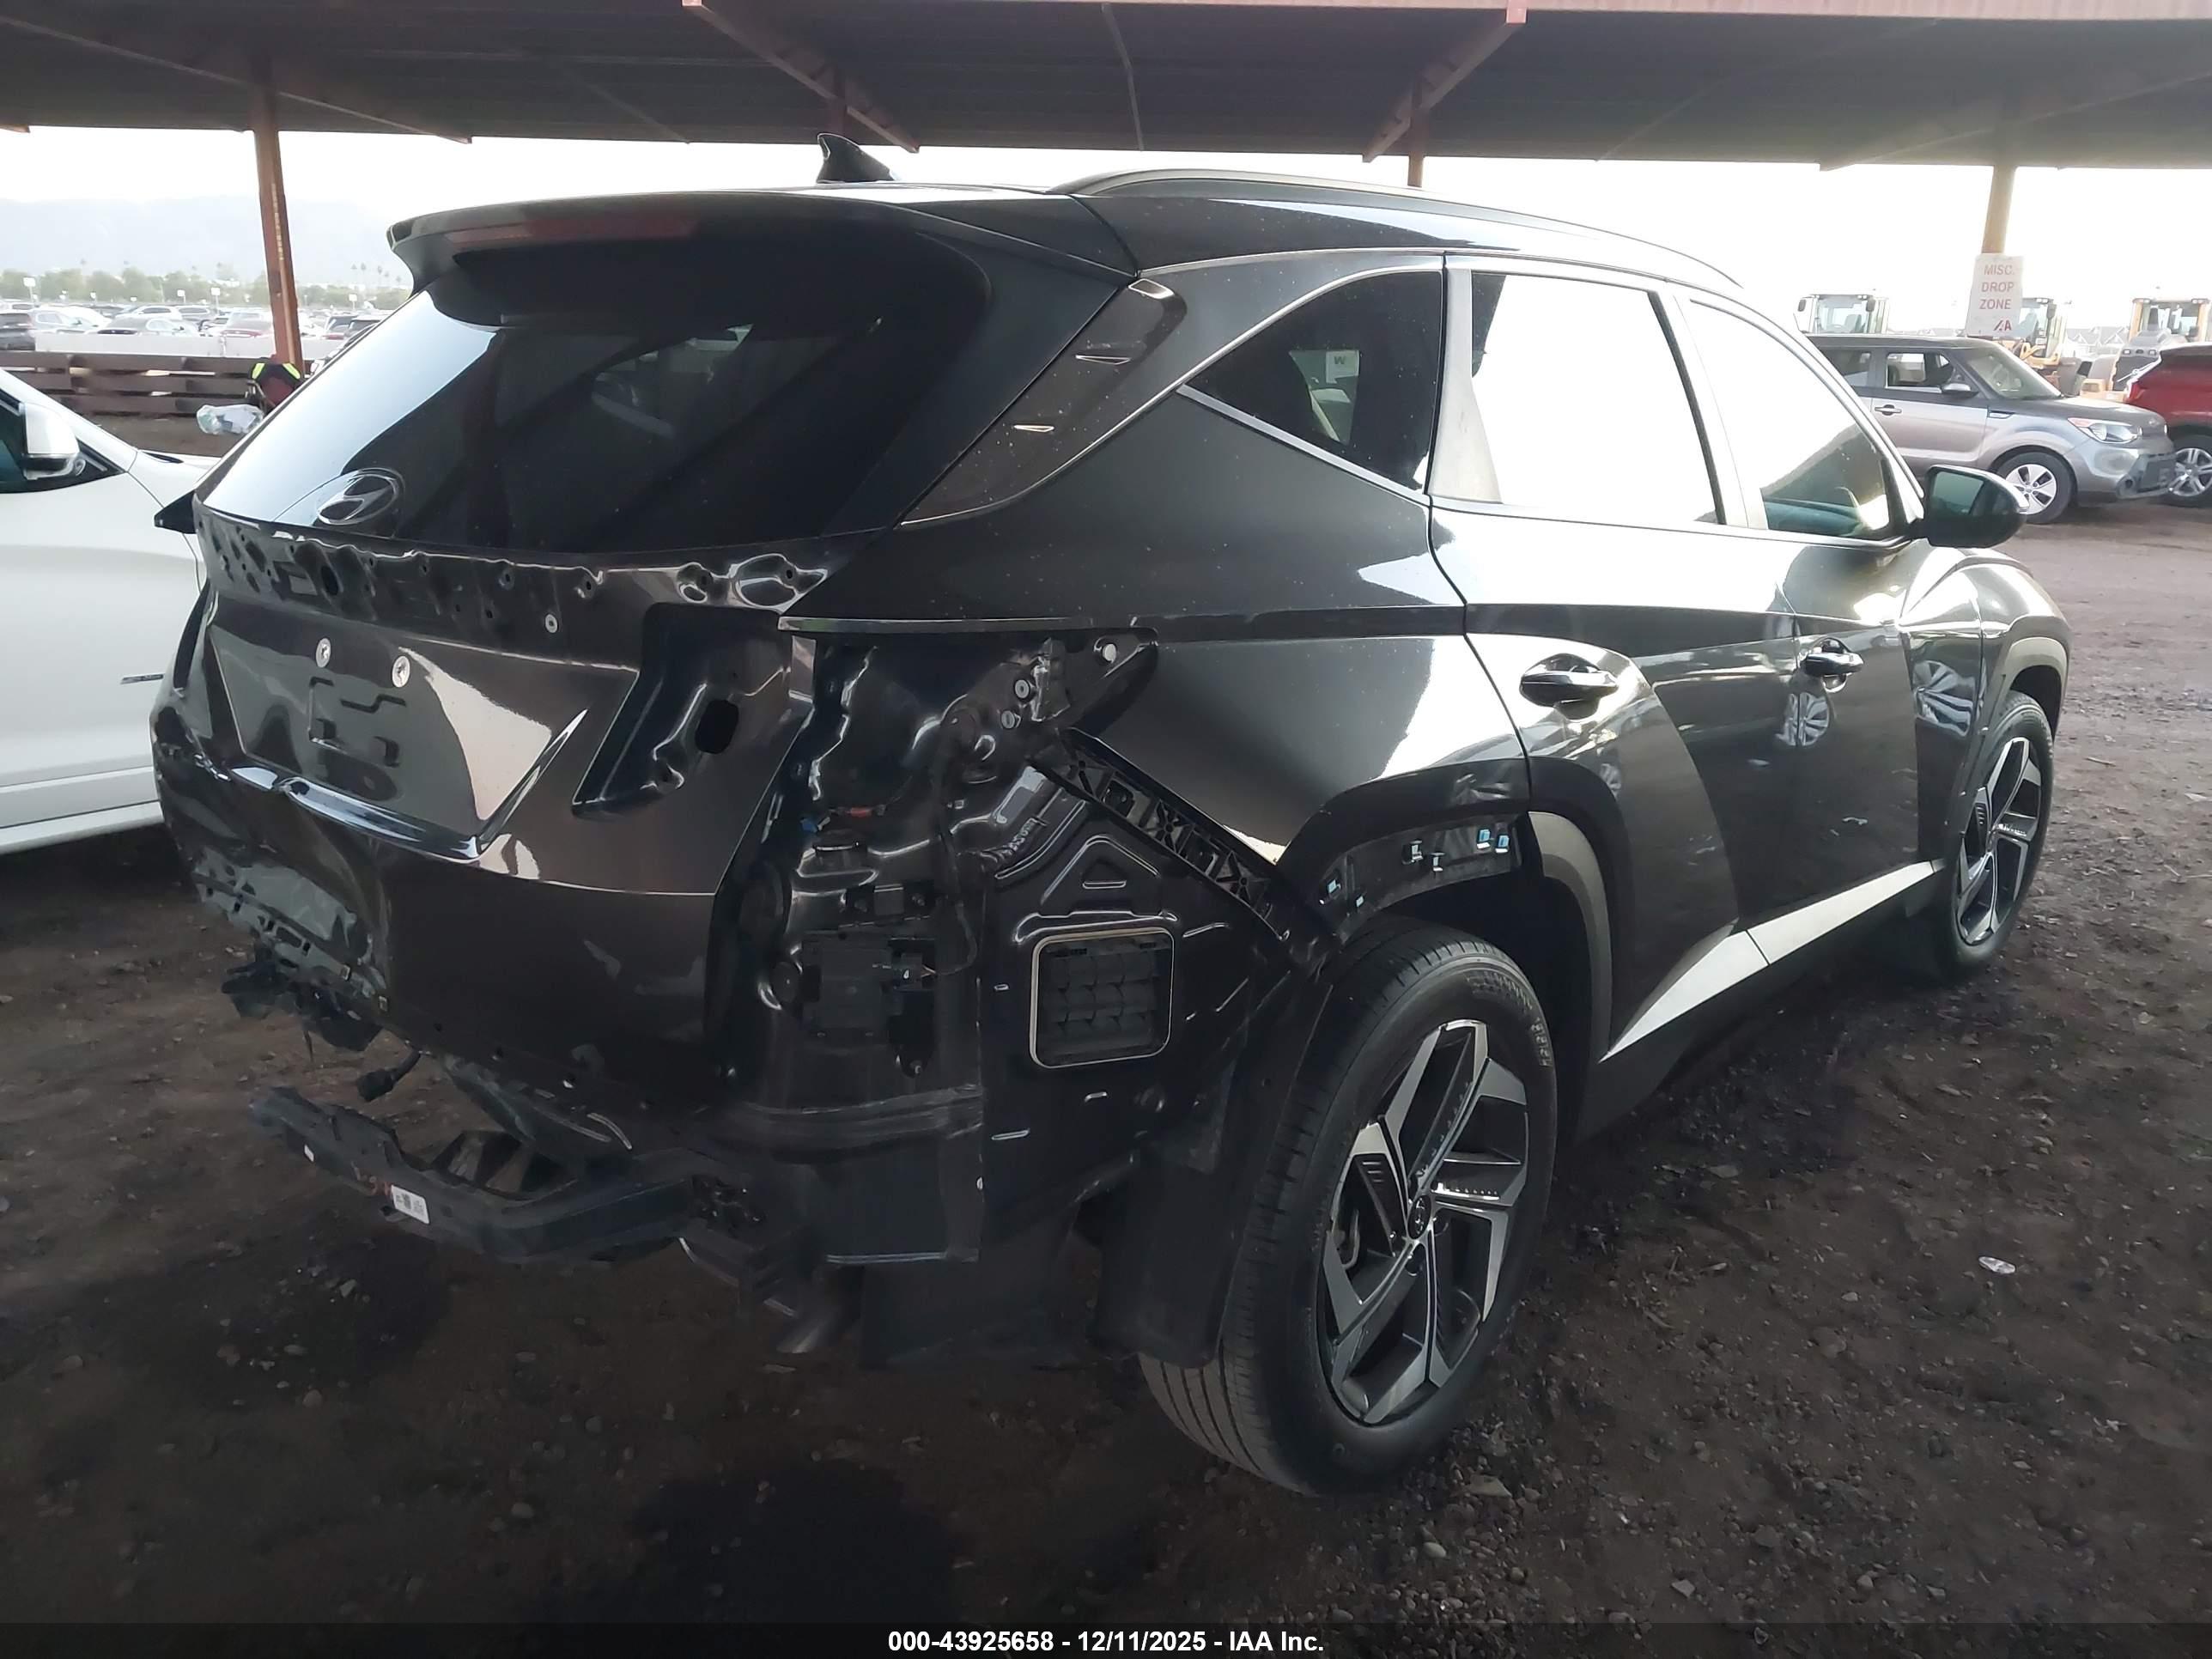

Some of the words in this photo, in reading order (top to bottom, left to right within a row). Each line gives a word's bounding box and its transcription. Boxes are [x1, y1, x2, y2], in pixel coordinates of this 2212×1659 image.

[1984, 264, 2015, 276] MISC.
[1981, 282, 2014, 292] DROP
[1978, 299, 2012, 309] ZONE
